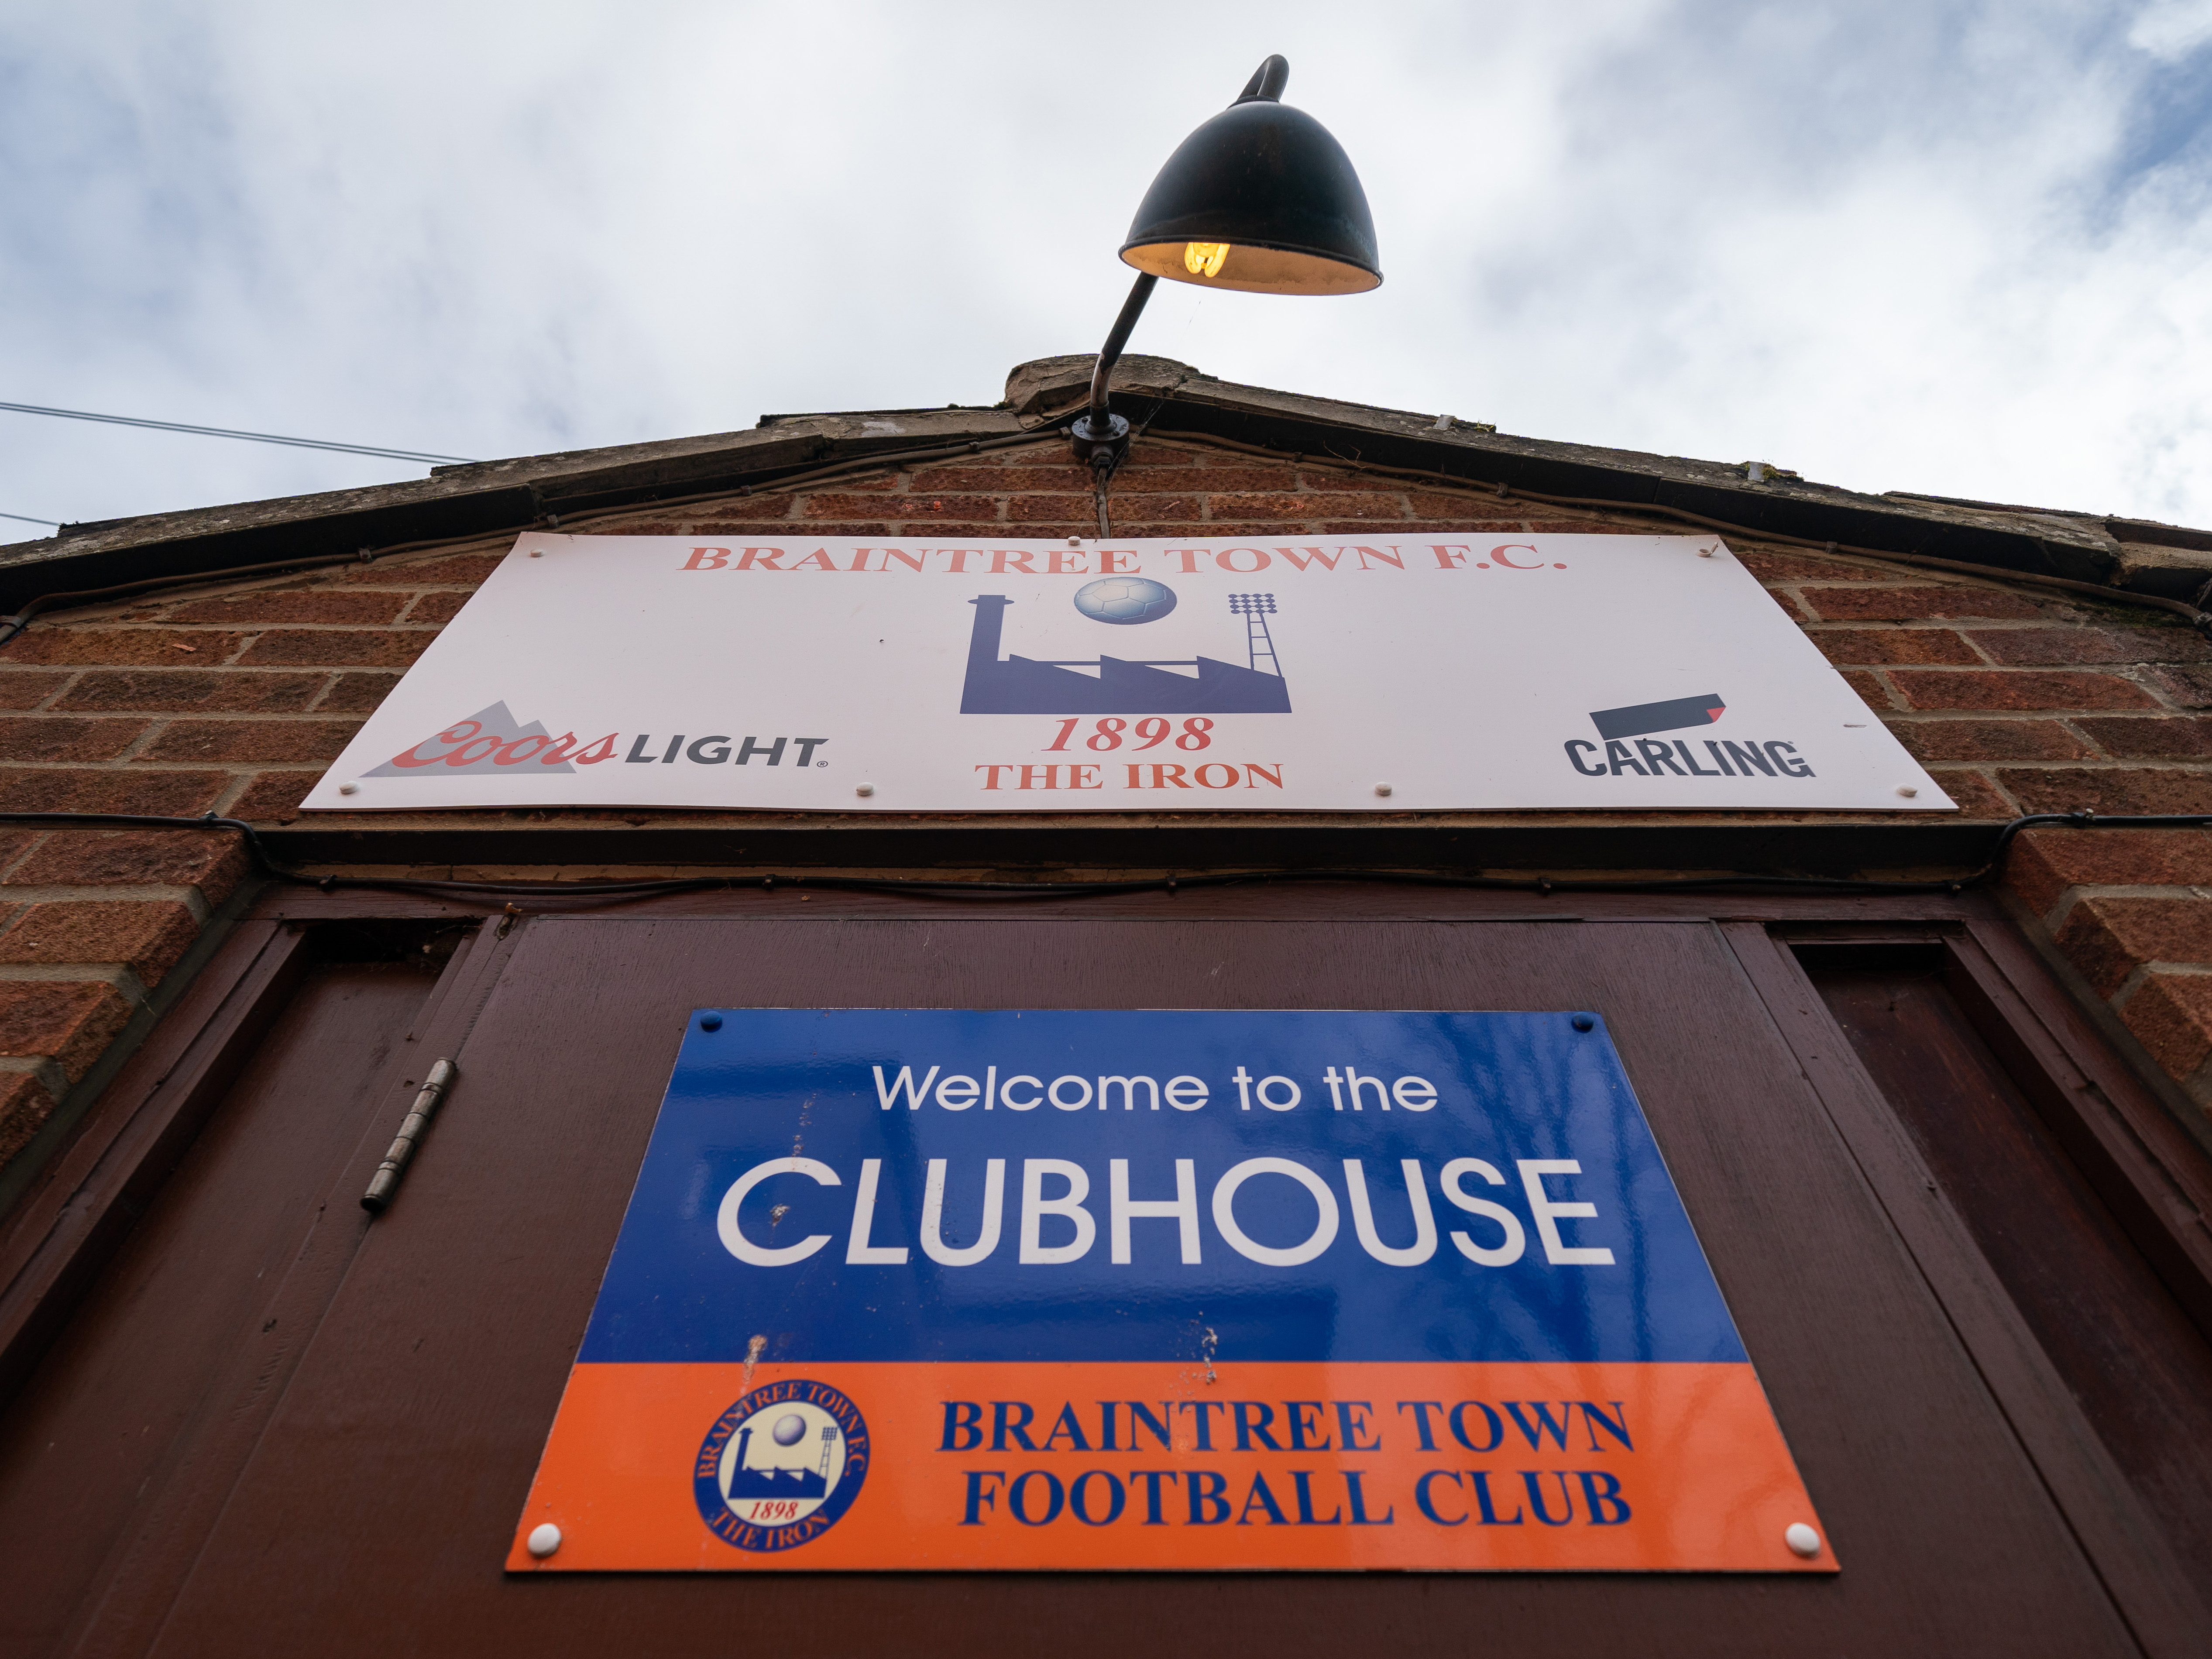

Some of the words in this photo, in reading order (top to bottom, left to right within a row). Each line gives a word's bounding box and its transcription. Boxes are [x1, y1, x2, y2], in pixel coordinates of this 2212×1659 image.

[676, 547, 1142, 574] BRAINTREE
[1164, 545, 1406, 573] TOWN
[1425, 544, 1568, 570] F.C.
[391, 720, 620, 767] Coors
[1041, 717, 1214, 751] 1898
[974, 765, 1103, 790] THE
[1122, 763, 1284, 790] IRON
[872, 1065, 1209, 1111] Welcome
[1232, 1066, 1301, 1112] to
[1322, 1066, 1439, 1112] the
[717, 1157, 1616, 1267] CLUBHOUSE
[697, 1381, 802, 1479] BRAINTREE
[807, 1382, 862, 1434] TOWN
[845, 1436, 867, 1477] F.C.
[934, 1400, 1382, 1453] BRAINTREE
[1397, 1400, 1635, 1453] TOWN
[747, 1500, 800, 1521] 1898
[957, 1469, 1395, 1527] FOOTBALL
[1414, 1469, 1632, 1527] CLUB
[711, 1506, 762, 1549] THE
[764, 1508, 831, 1549] IRON
